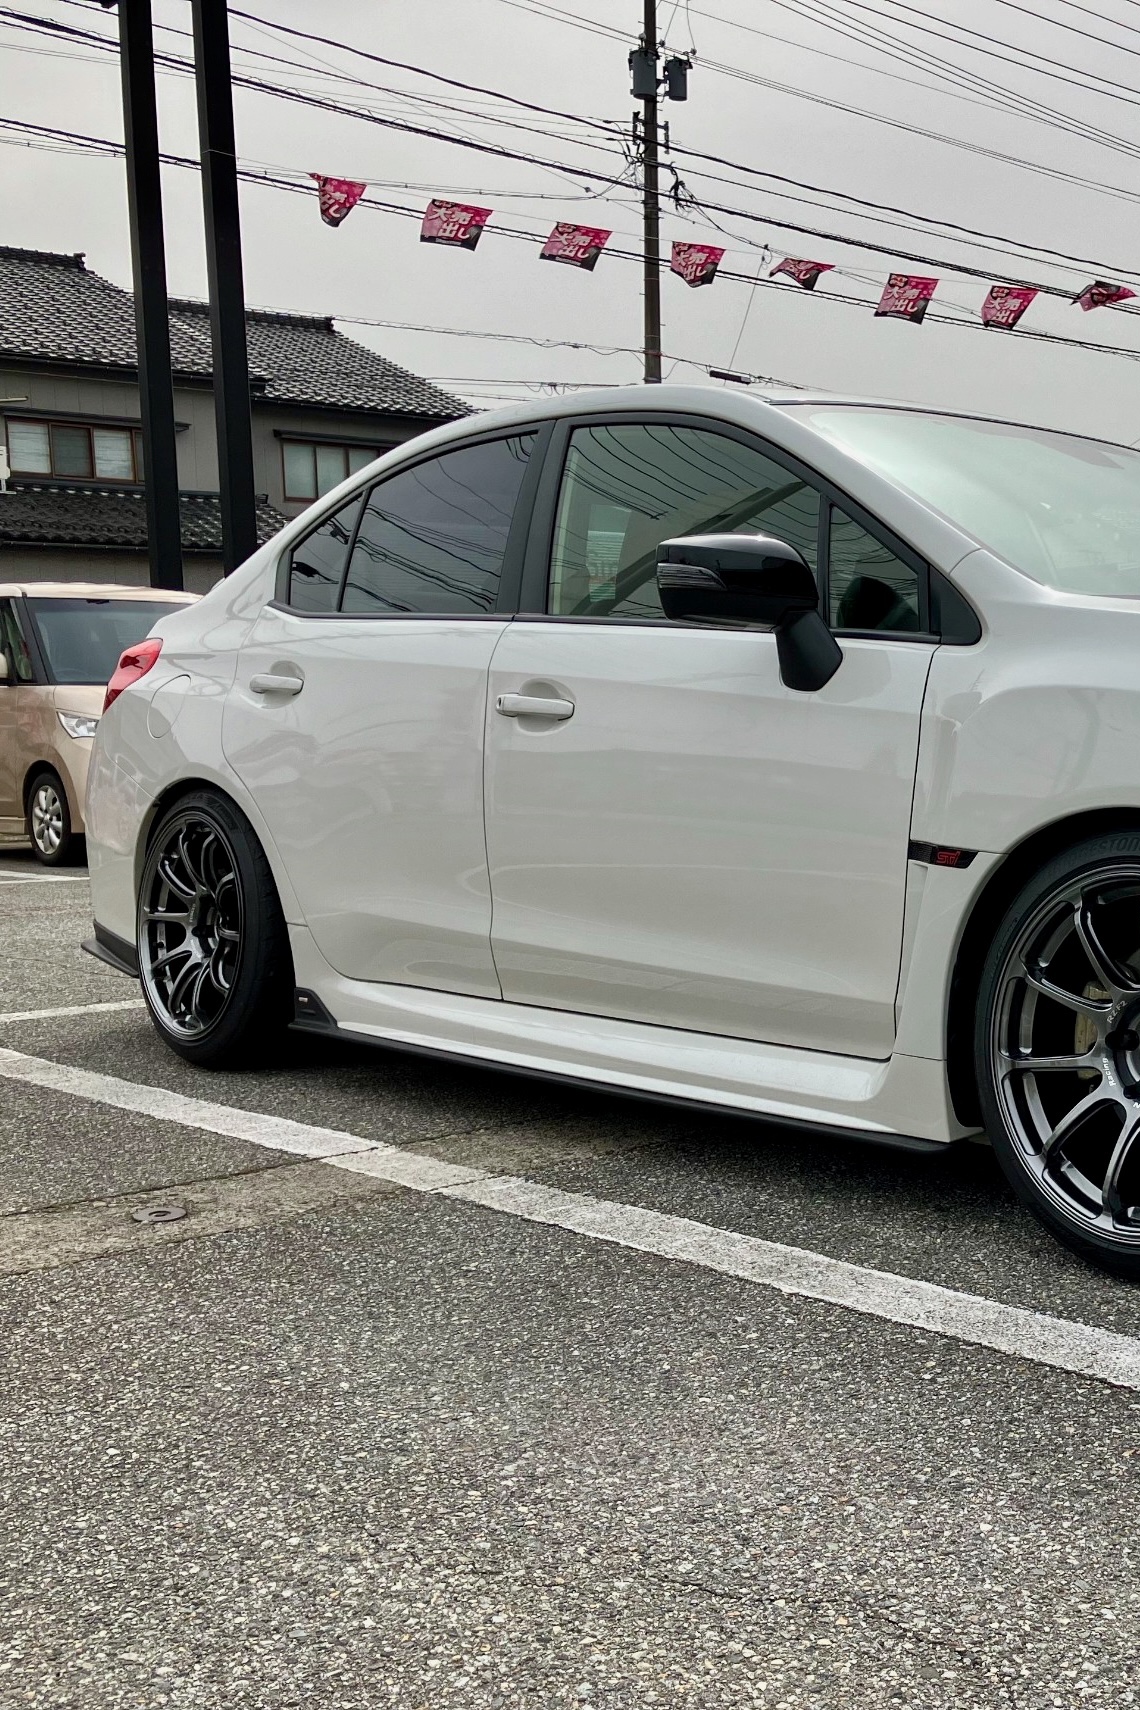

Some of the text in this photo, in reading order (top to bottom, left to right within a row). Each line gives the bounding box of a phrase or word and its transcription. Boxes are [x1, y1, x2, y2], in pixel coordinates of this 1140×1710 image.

[438, 222, 470, 240] 出し
[558, 244, 590, 259] 出し
[890, 299, 918, 313] 出し
[1102, 1057, 1117, 1087] Racing
